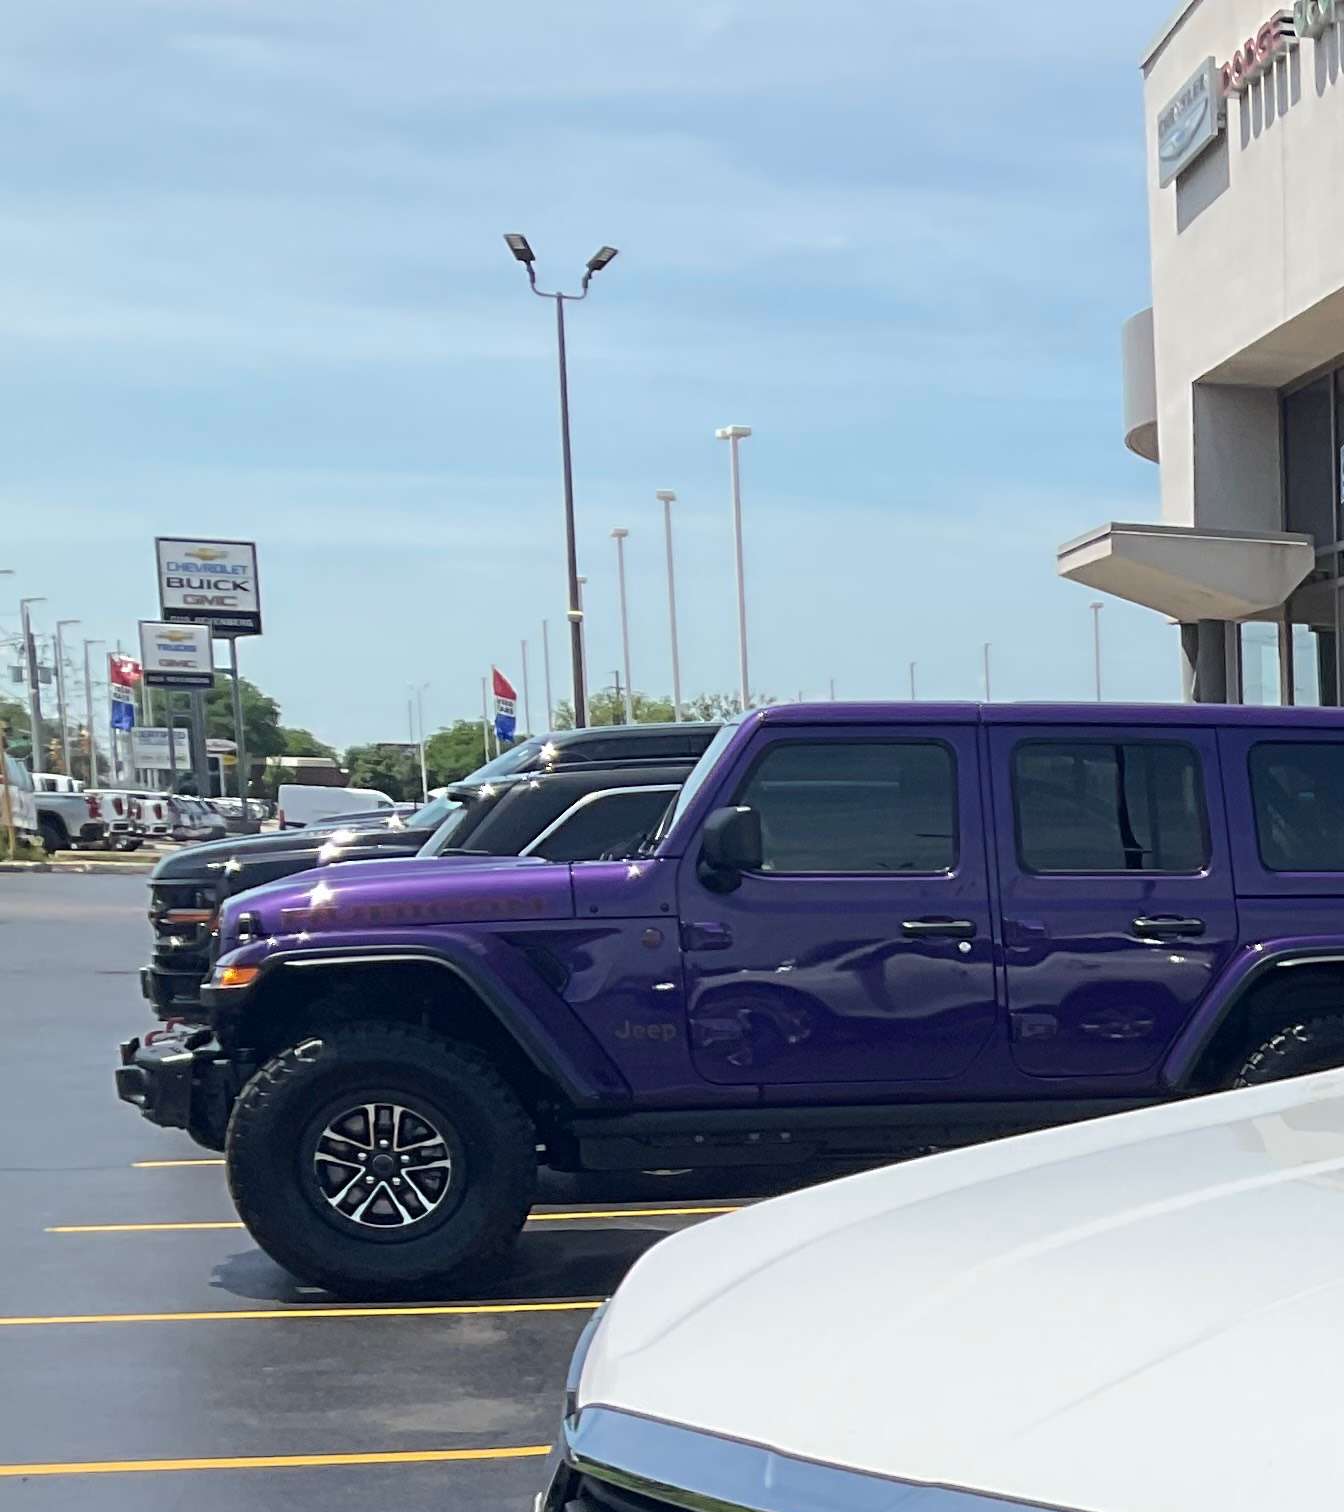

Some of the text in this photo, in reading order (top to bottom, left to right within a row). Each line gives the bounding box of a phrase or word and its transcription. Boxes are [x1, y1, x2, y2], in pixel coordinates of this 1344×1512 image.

[166, 561, 249, 575] CHEVROLET
[166, 577, 250, 592] BUICK
[182, 594, 239, 607] GMC
[615, 1020, 677, 1041] Jeep
